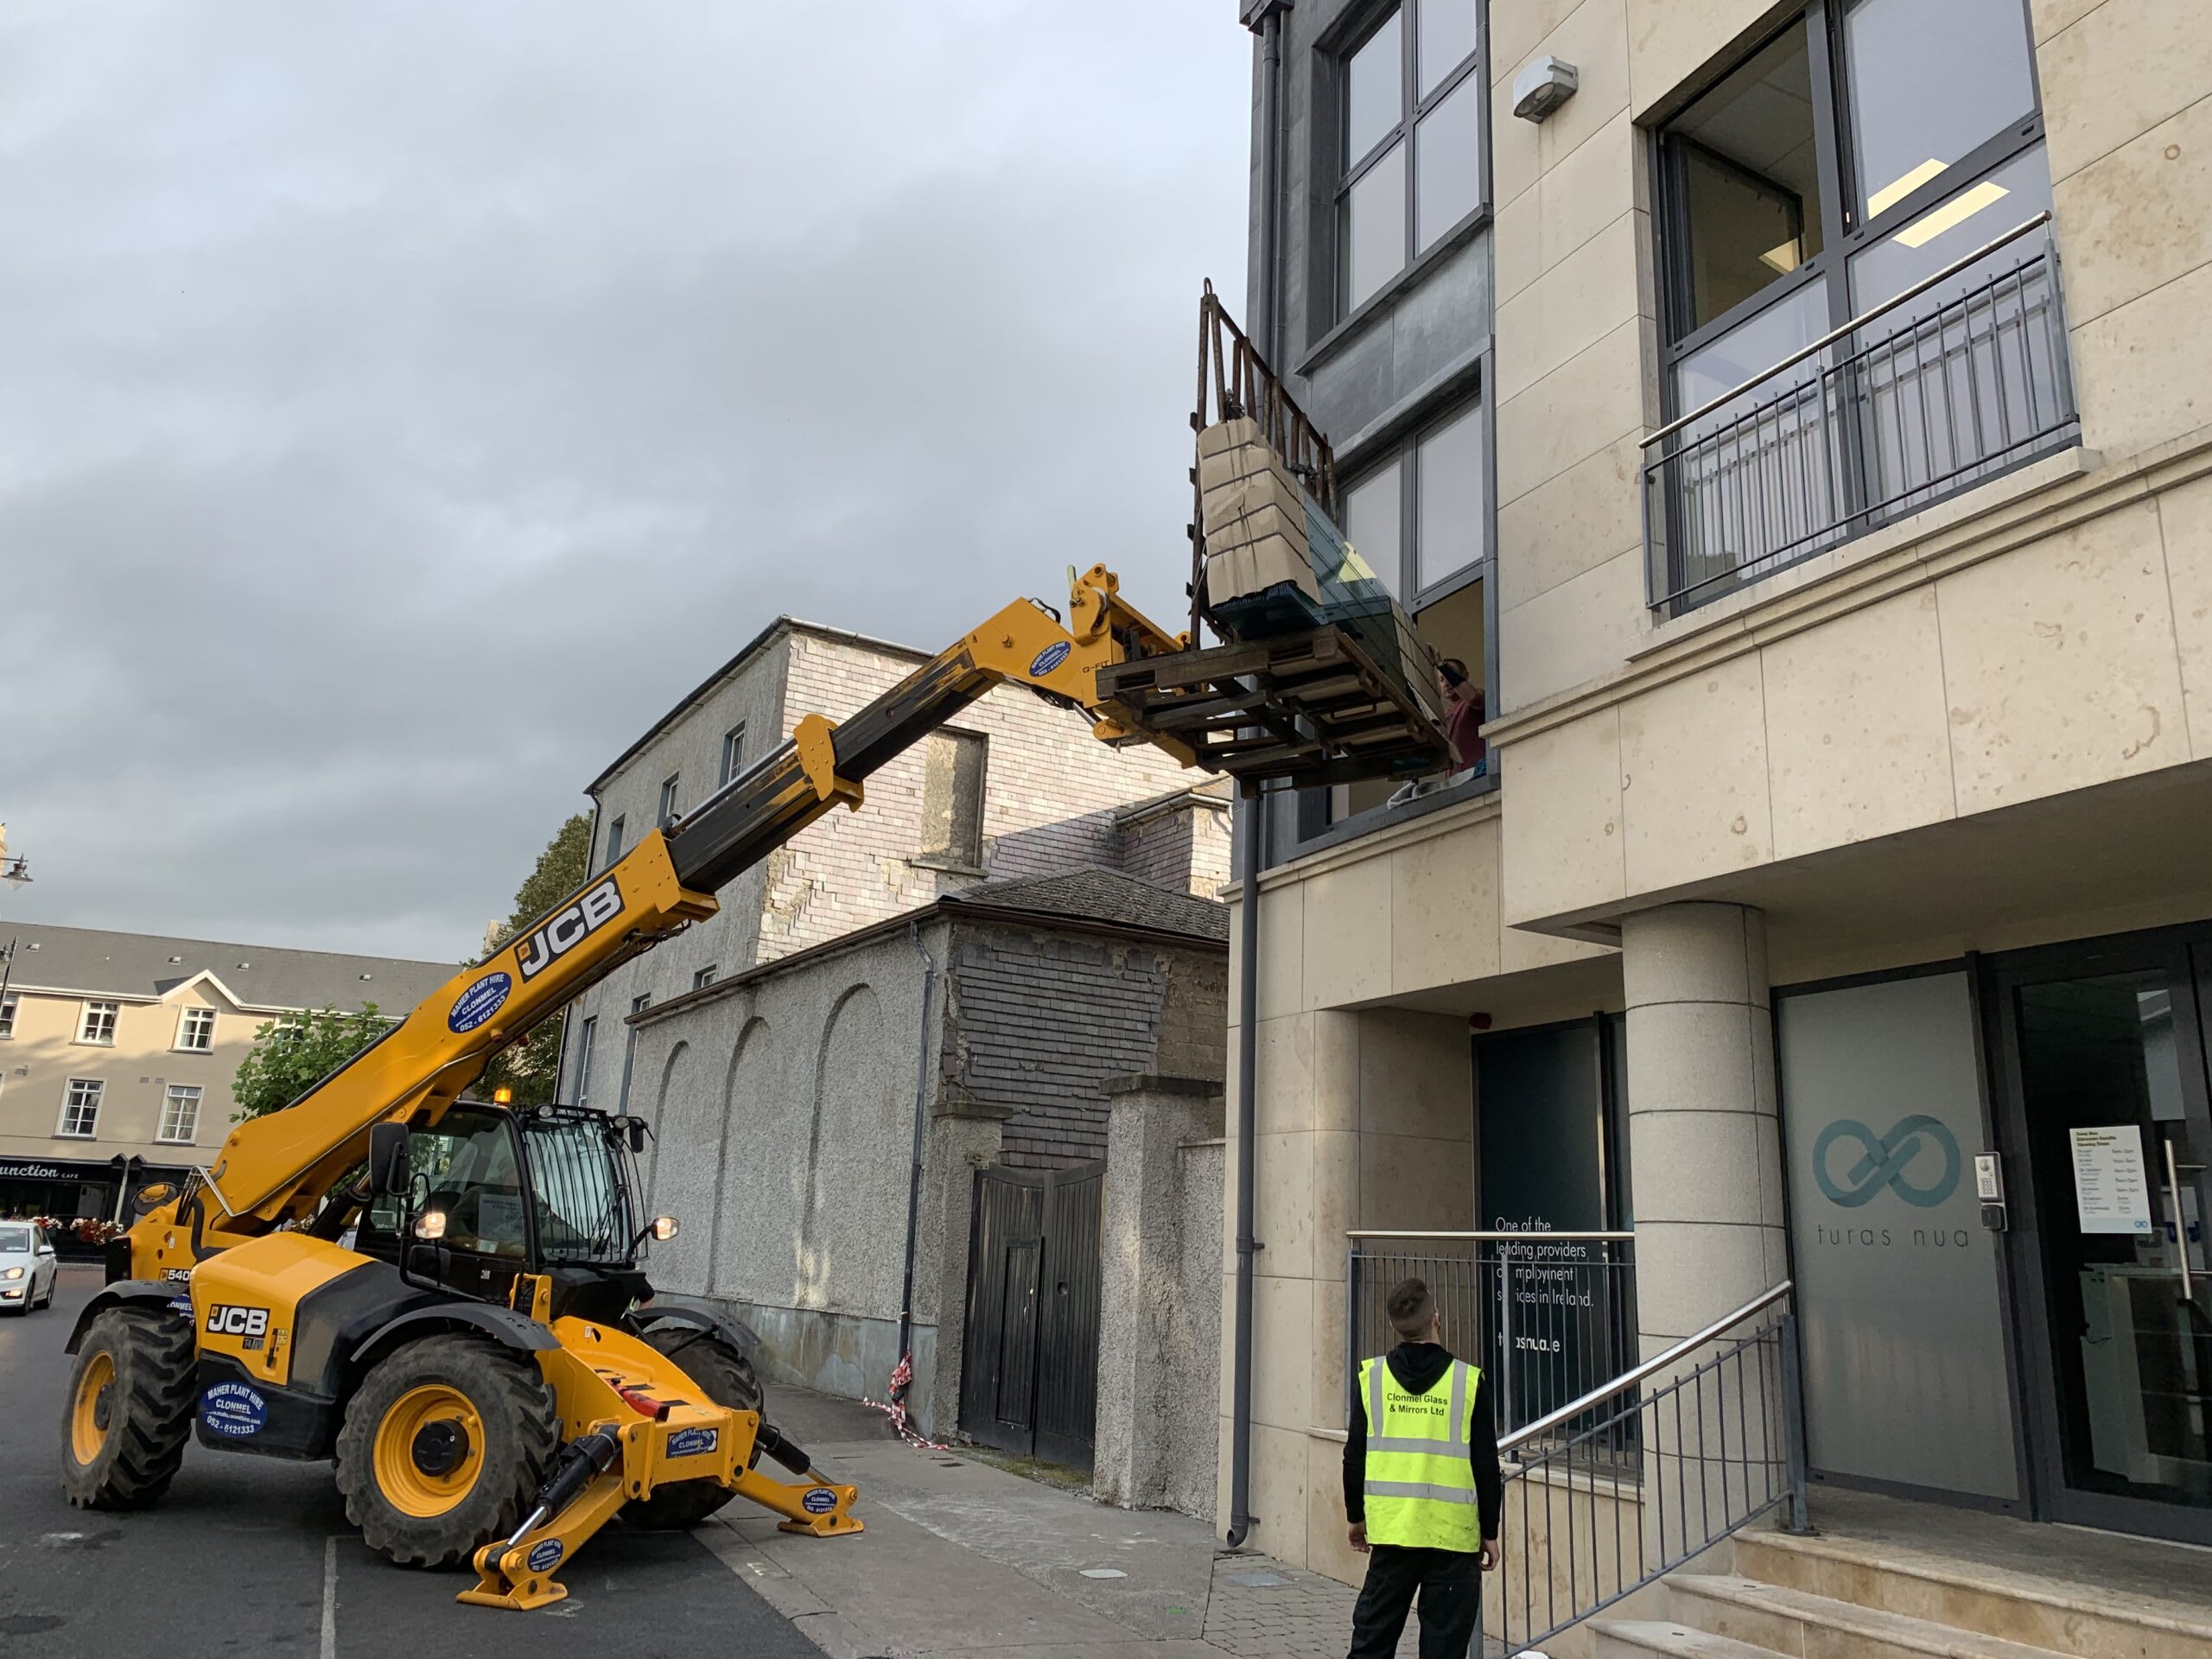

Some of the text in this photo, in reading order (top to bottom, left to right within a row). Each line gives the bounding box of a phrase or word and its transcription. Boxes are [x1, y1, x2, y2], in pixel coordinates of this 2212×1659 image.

[521, 881, 621, 976] JCB
[450, 974, 505, 1018] MAHER PLANT HIRE
[461, 986, 497, 1015] CLONMEL
[460, 1021, 474, 1033] 052
[478, 995, 506, 1022] 6121333
[0, 1164, 60, 1178] unction
[1496, 1216, 1551, 1232] One of the
[1817, 1224, 1969, 1248] turas nua
[1537, 1241, 1586, 1260] providers
[1516, 1263, 1573, 1284] mployment
[1539, 1289, 1549, 1304] in
[207, 1306, 268, 1336] JCB
[207, 1384, 264, 1411] MAHER PLANT HIRE
[215, 1398, 251, 1414] CLONMEL
[1387, 1392, 1448, 1406] Clonmel Glass
[1389, 1403, 1445, 1416] & Mirrors Ltd
[207, 1415, 220, 1429] 052
[224, 1424, 255, 1434] 6121333
